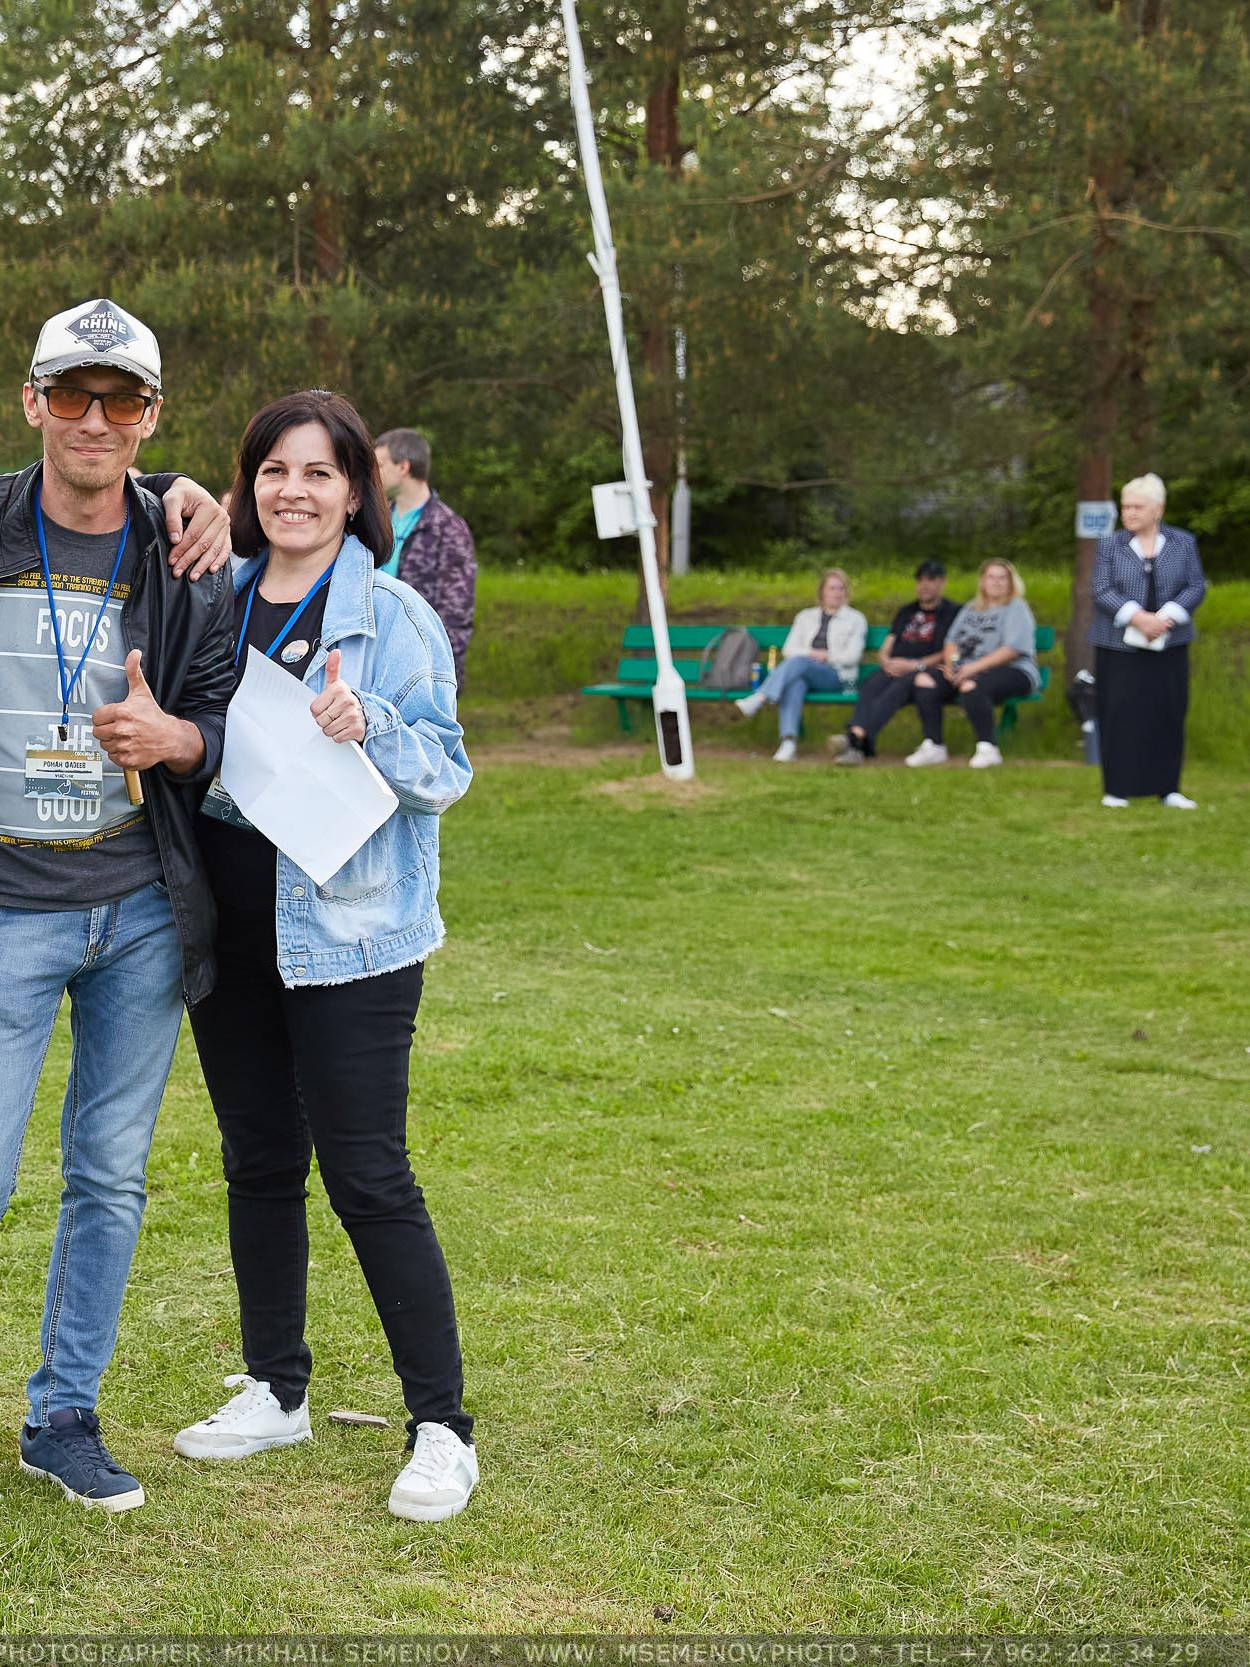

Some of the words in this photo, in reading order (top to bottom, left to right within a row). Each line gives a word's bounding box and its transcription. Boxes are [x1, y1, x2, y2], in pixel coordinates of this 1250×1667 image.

[79, 318, 127, 335] RHINE
[17, 579, 39, 588] SPECIAL
[65, 582, 92, 592] TRAINING
[102, 587, 129, 599] PEMIUM
[30, 572, 41, 580] FEEL
[62, 574, 68, 582] IS
[69, 575, 81, 583] THE
[81, 576, 110, 588] STRENGTH
[120, 582, 131, 593] FEEL
[36, 607, 111, 653] FOCUS
[56, 666, 88, 705] ON
[48, 723, 95, 751] THE
[43, 760, 63, 768] РОМАН
[64, 760, 86, 769] ФАДЕЕВ
[36, 799, 101, 823] GOOD
